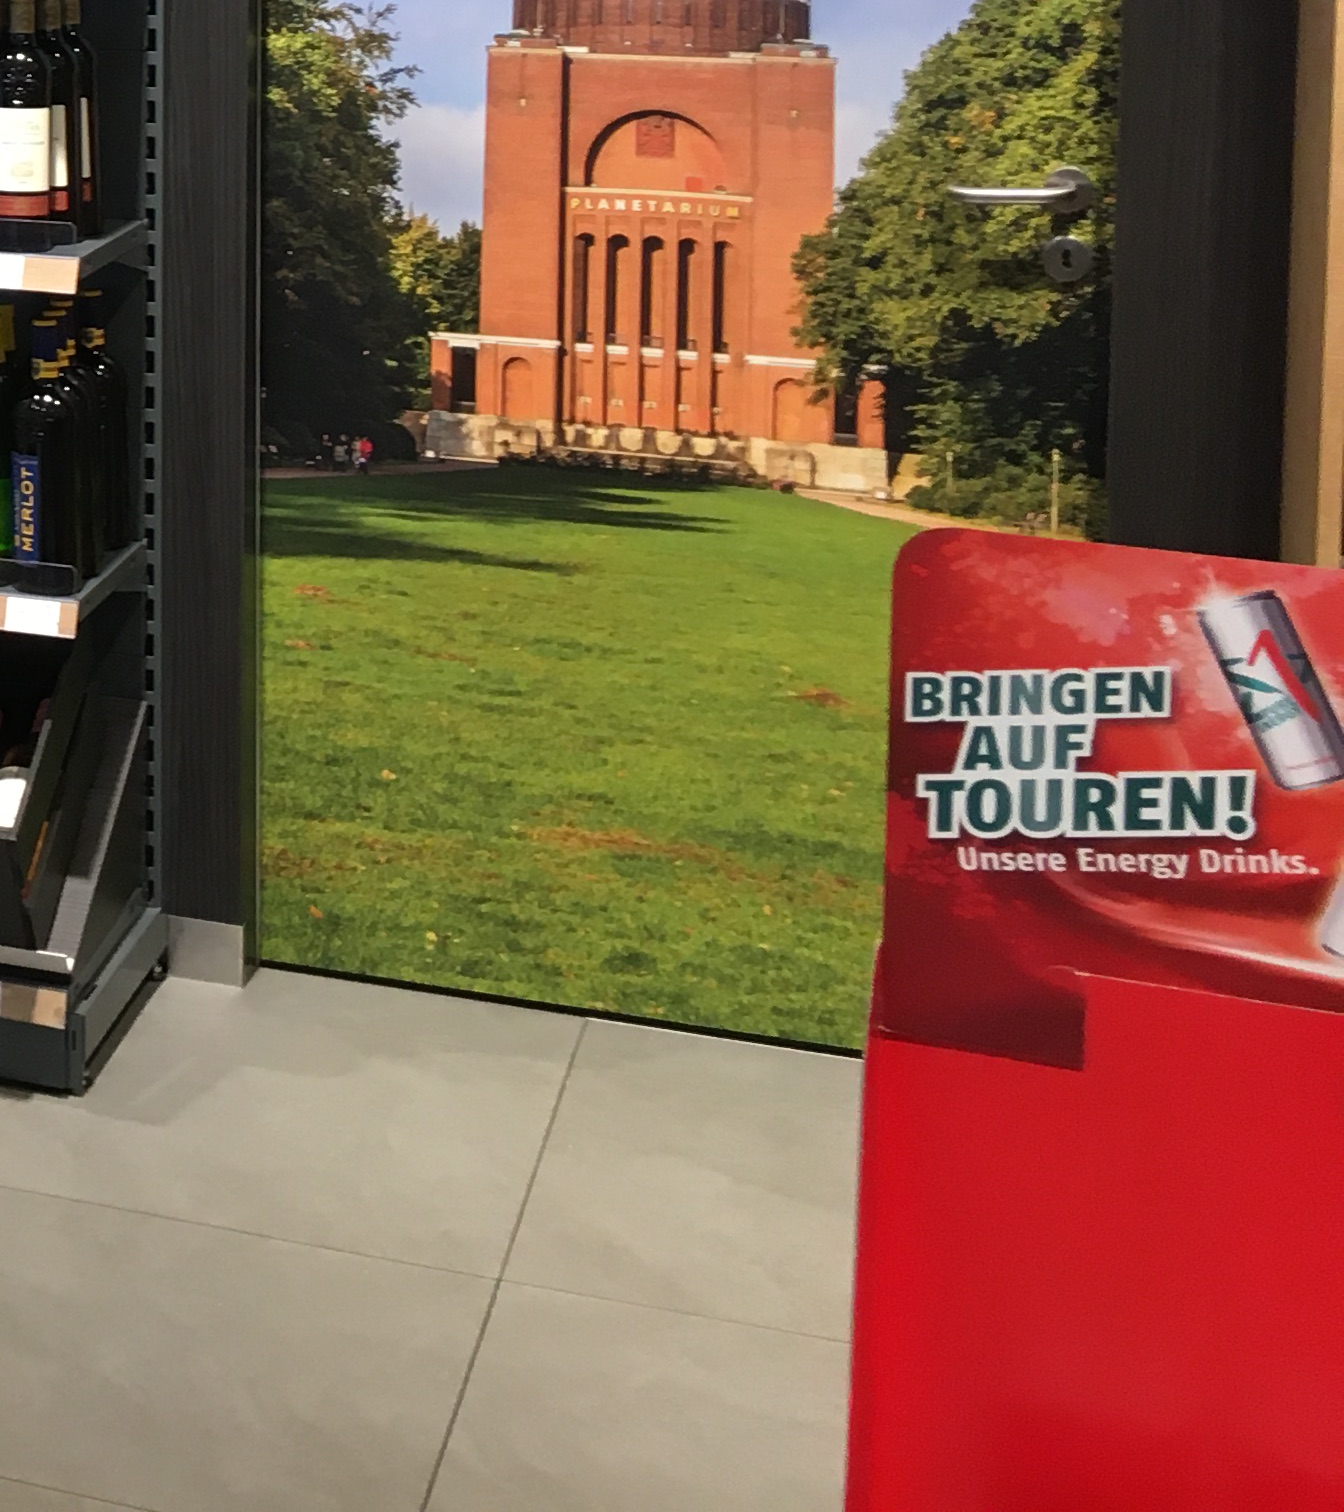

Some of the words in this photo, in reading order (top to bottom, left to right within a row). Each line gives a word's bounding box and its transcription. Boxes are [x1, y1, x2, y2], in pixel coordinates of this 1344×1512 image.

[569, 196, 741, 220] PLANETARIUM
[21, 466, 35, 552] MERLOT
[909, 669, 1168, 719] BRINGEN
[961, 722, 1091, 772] AUF
[922, 775, 1254, 836] TOUREN!
[957, 845, 1067, 874] Unsere
[1076, 847, 1189, 879] Energy
[1199, 848, 1320, 875] Drinks.
